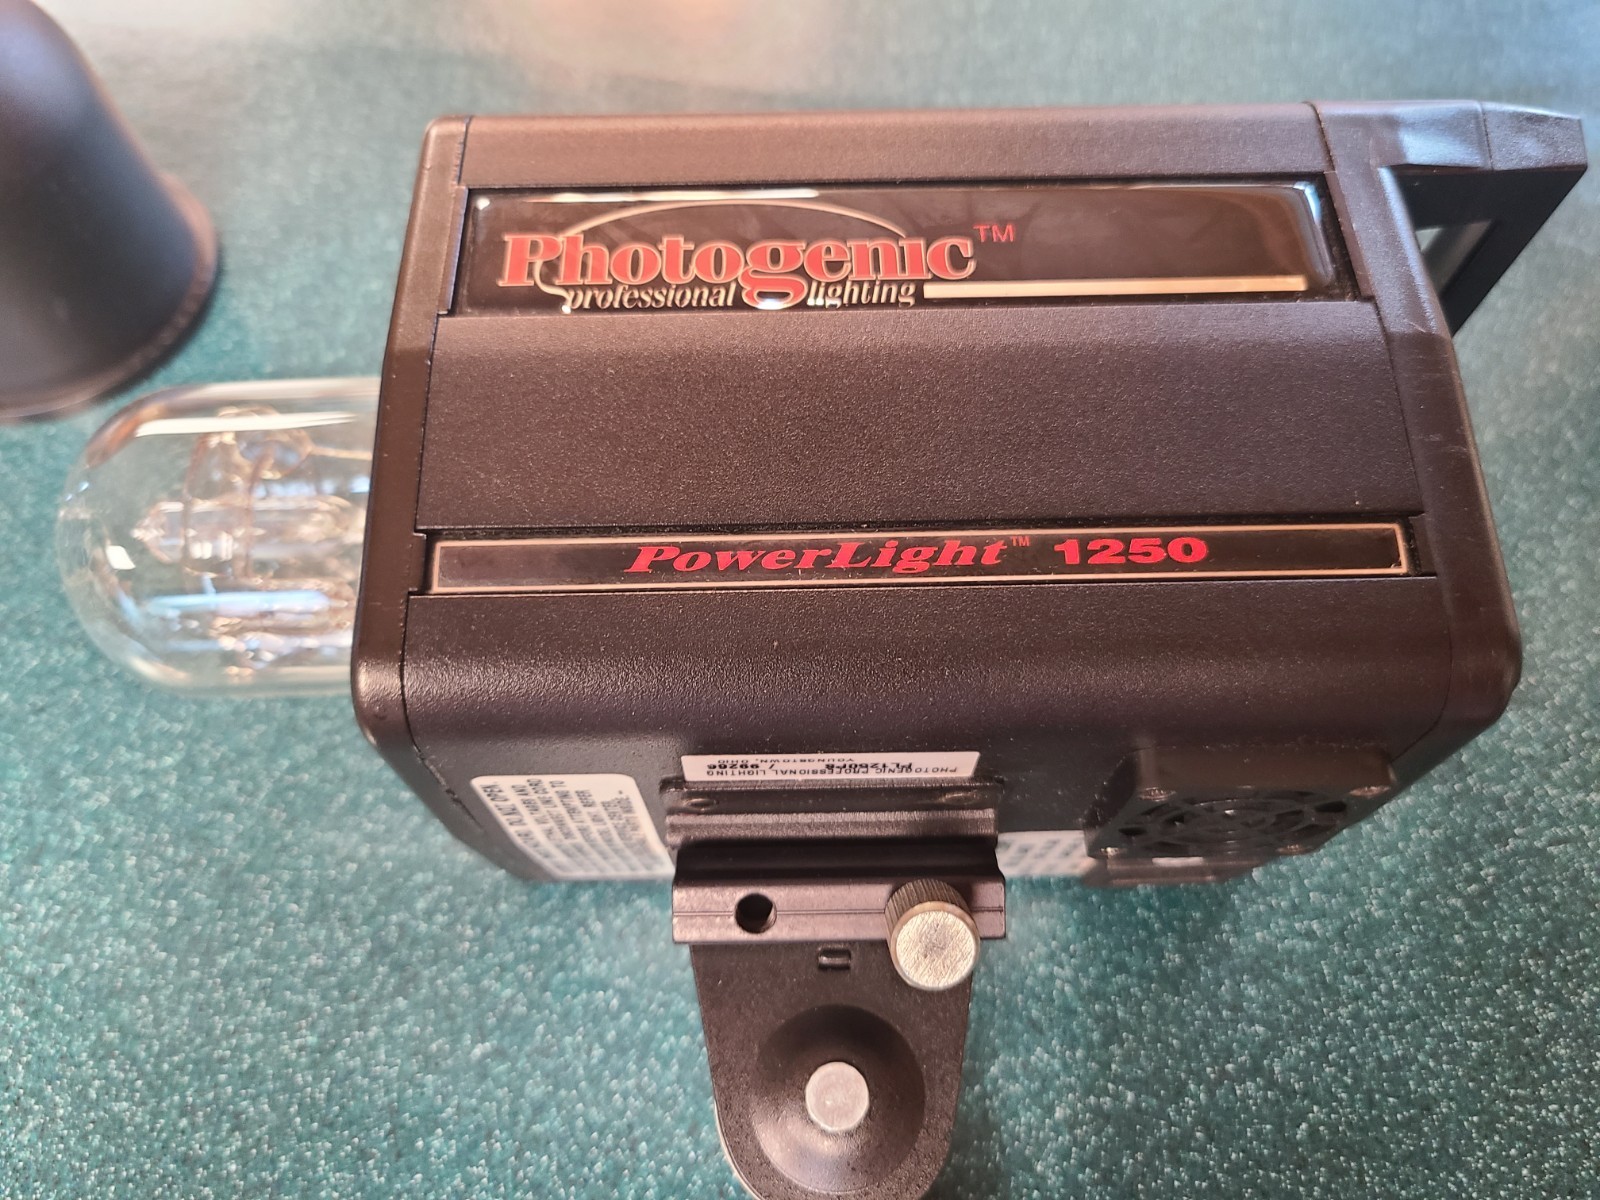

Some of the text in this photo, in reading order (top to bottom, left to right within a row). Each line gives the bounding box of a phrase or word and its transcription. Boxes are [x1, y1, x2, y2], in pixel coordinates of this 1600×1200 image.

[498, 223, 1017, 310] Photogenic TM
[563, 280, 917, 311] professional lighting
[624, 539, 1007, 576] PowerLight
[1053, 537, 1209, 565] 1250
